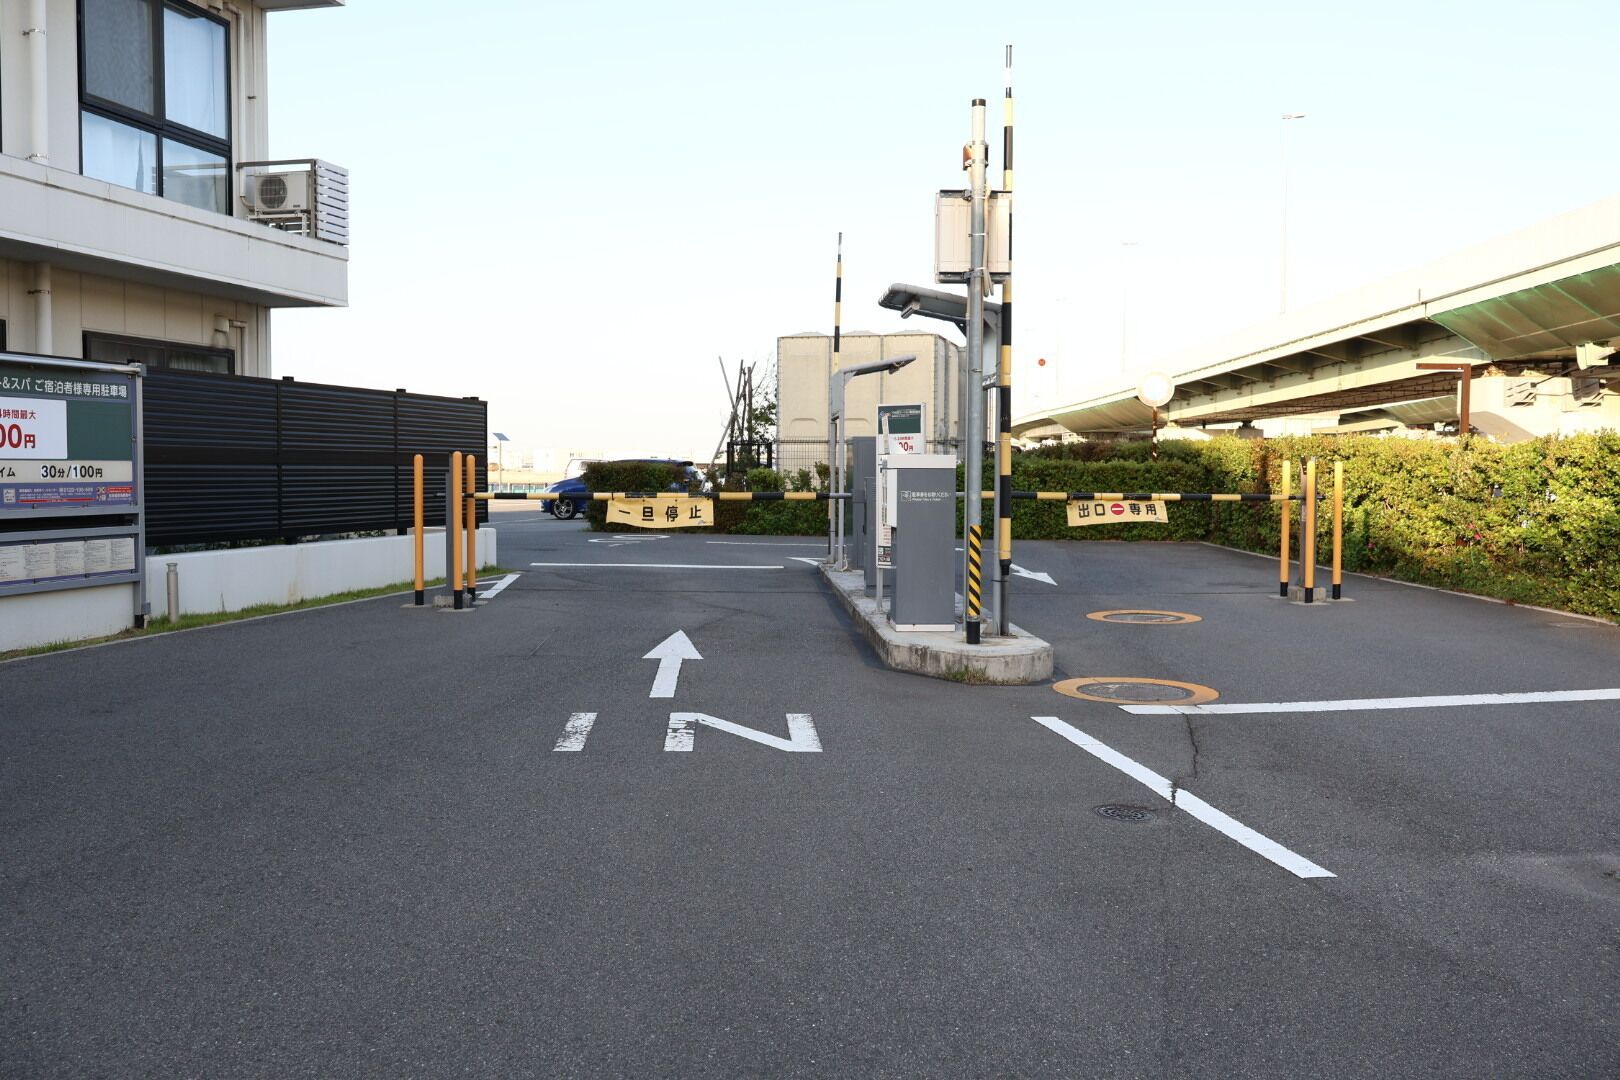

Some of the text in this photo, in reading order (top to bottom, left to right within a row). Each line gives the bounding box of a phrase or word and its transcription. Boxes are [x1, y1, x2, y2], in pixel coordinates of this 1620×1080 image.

[0, 376, 127, 398] &スパ ご宿泊者様専用駐車場
[0, 409, 36, 419] 時間最大
[41, 465, 103, 478] 30分/100円
[618, 505, 702, 522] 一旦停止
[1078, 503, 1157, 518] 出口 専用
[552, 712, 823, 752] IN
